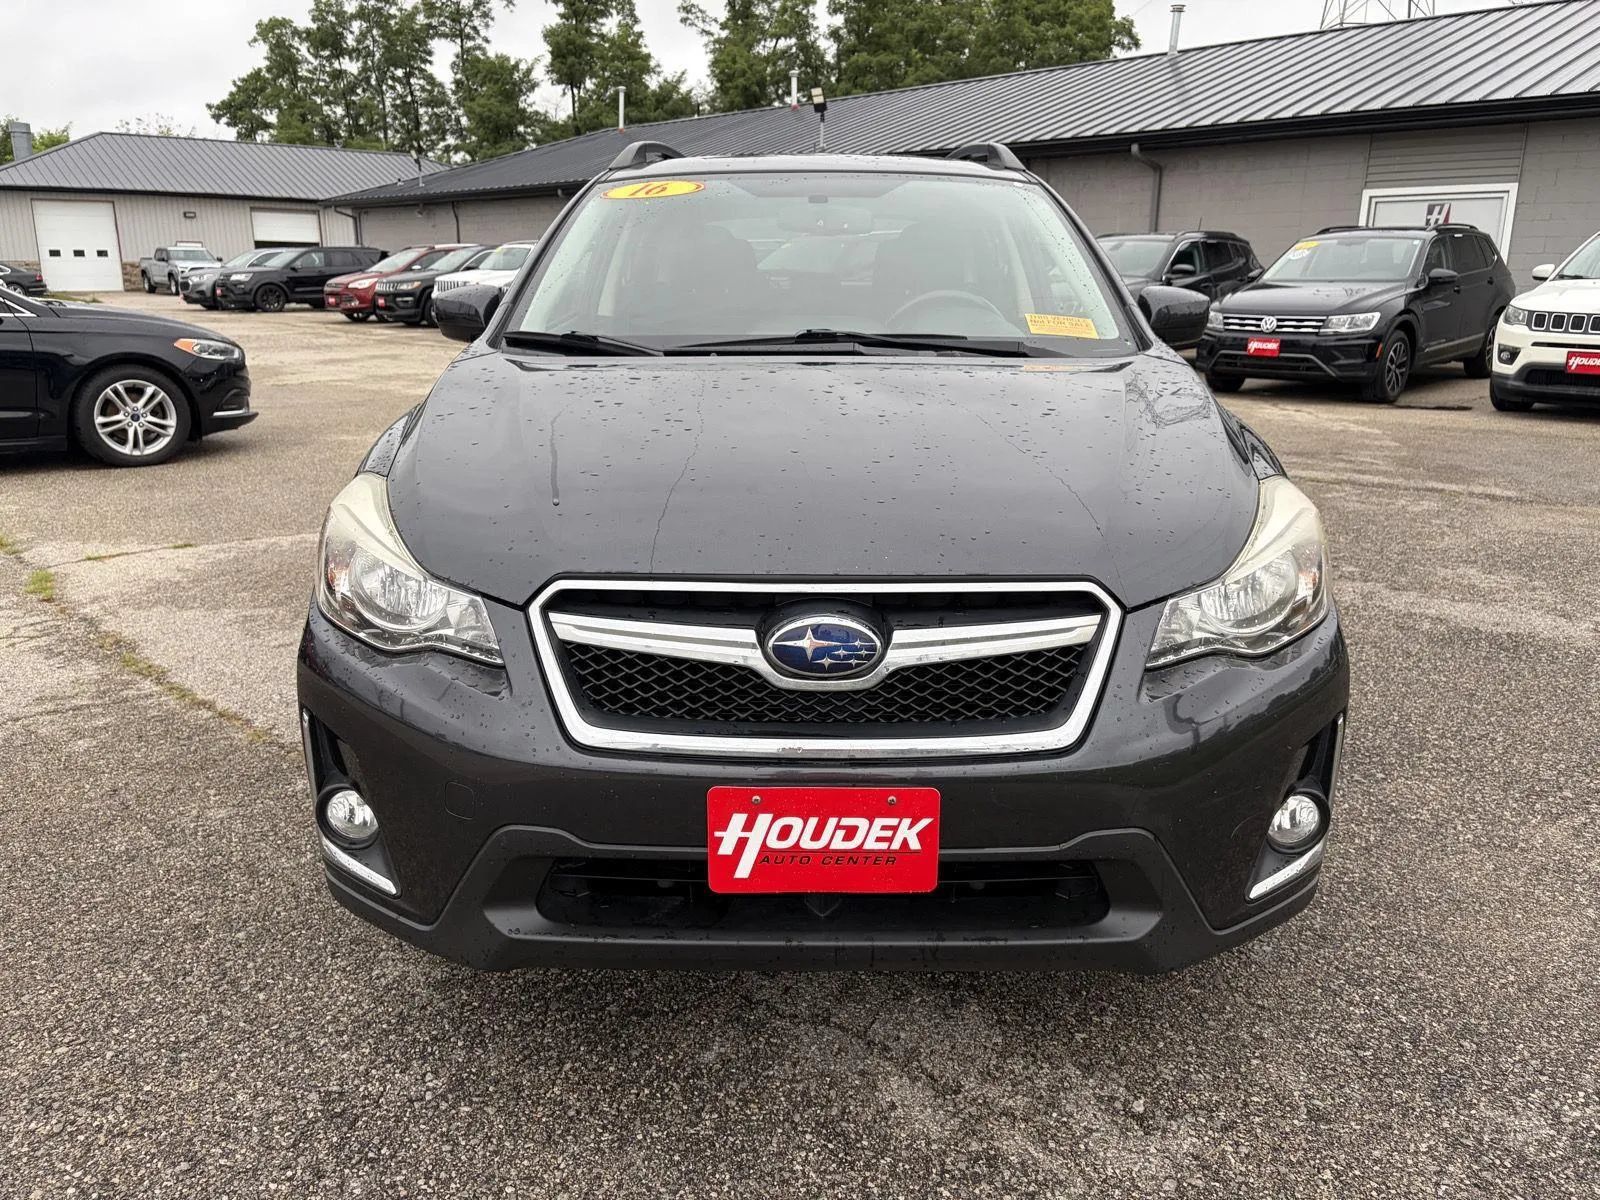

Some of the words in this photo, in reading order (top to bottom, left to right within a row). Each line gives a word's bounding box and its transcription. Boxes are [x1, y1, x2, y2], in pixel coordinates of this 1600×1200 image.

[628, 183, 669, 196] 16
[714, 813, 934, 879] HOUDEK
[759, 855, 812, 866] AUTO
[821, 855, 897, 866] CENTER
